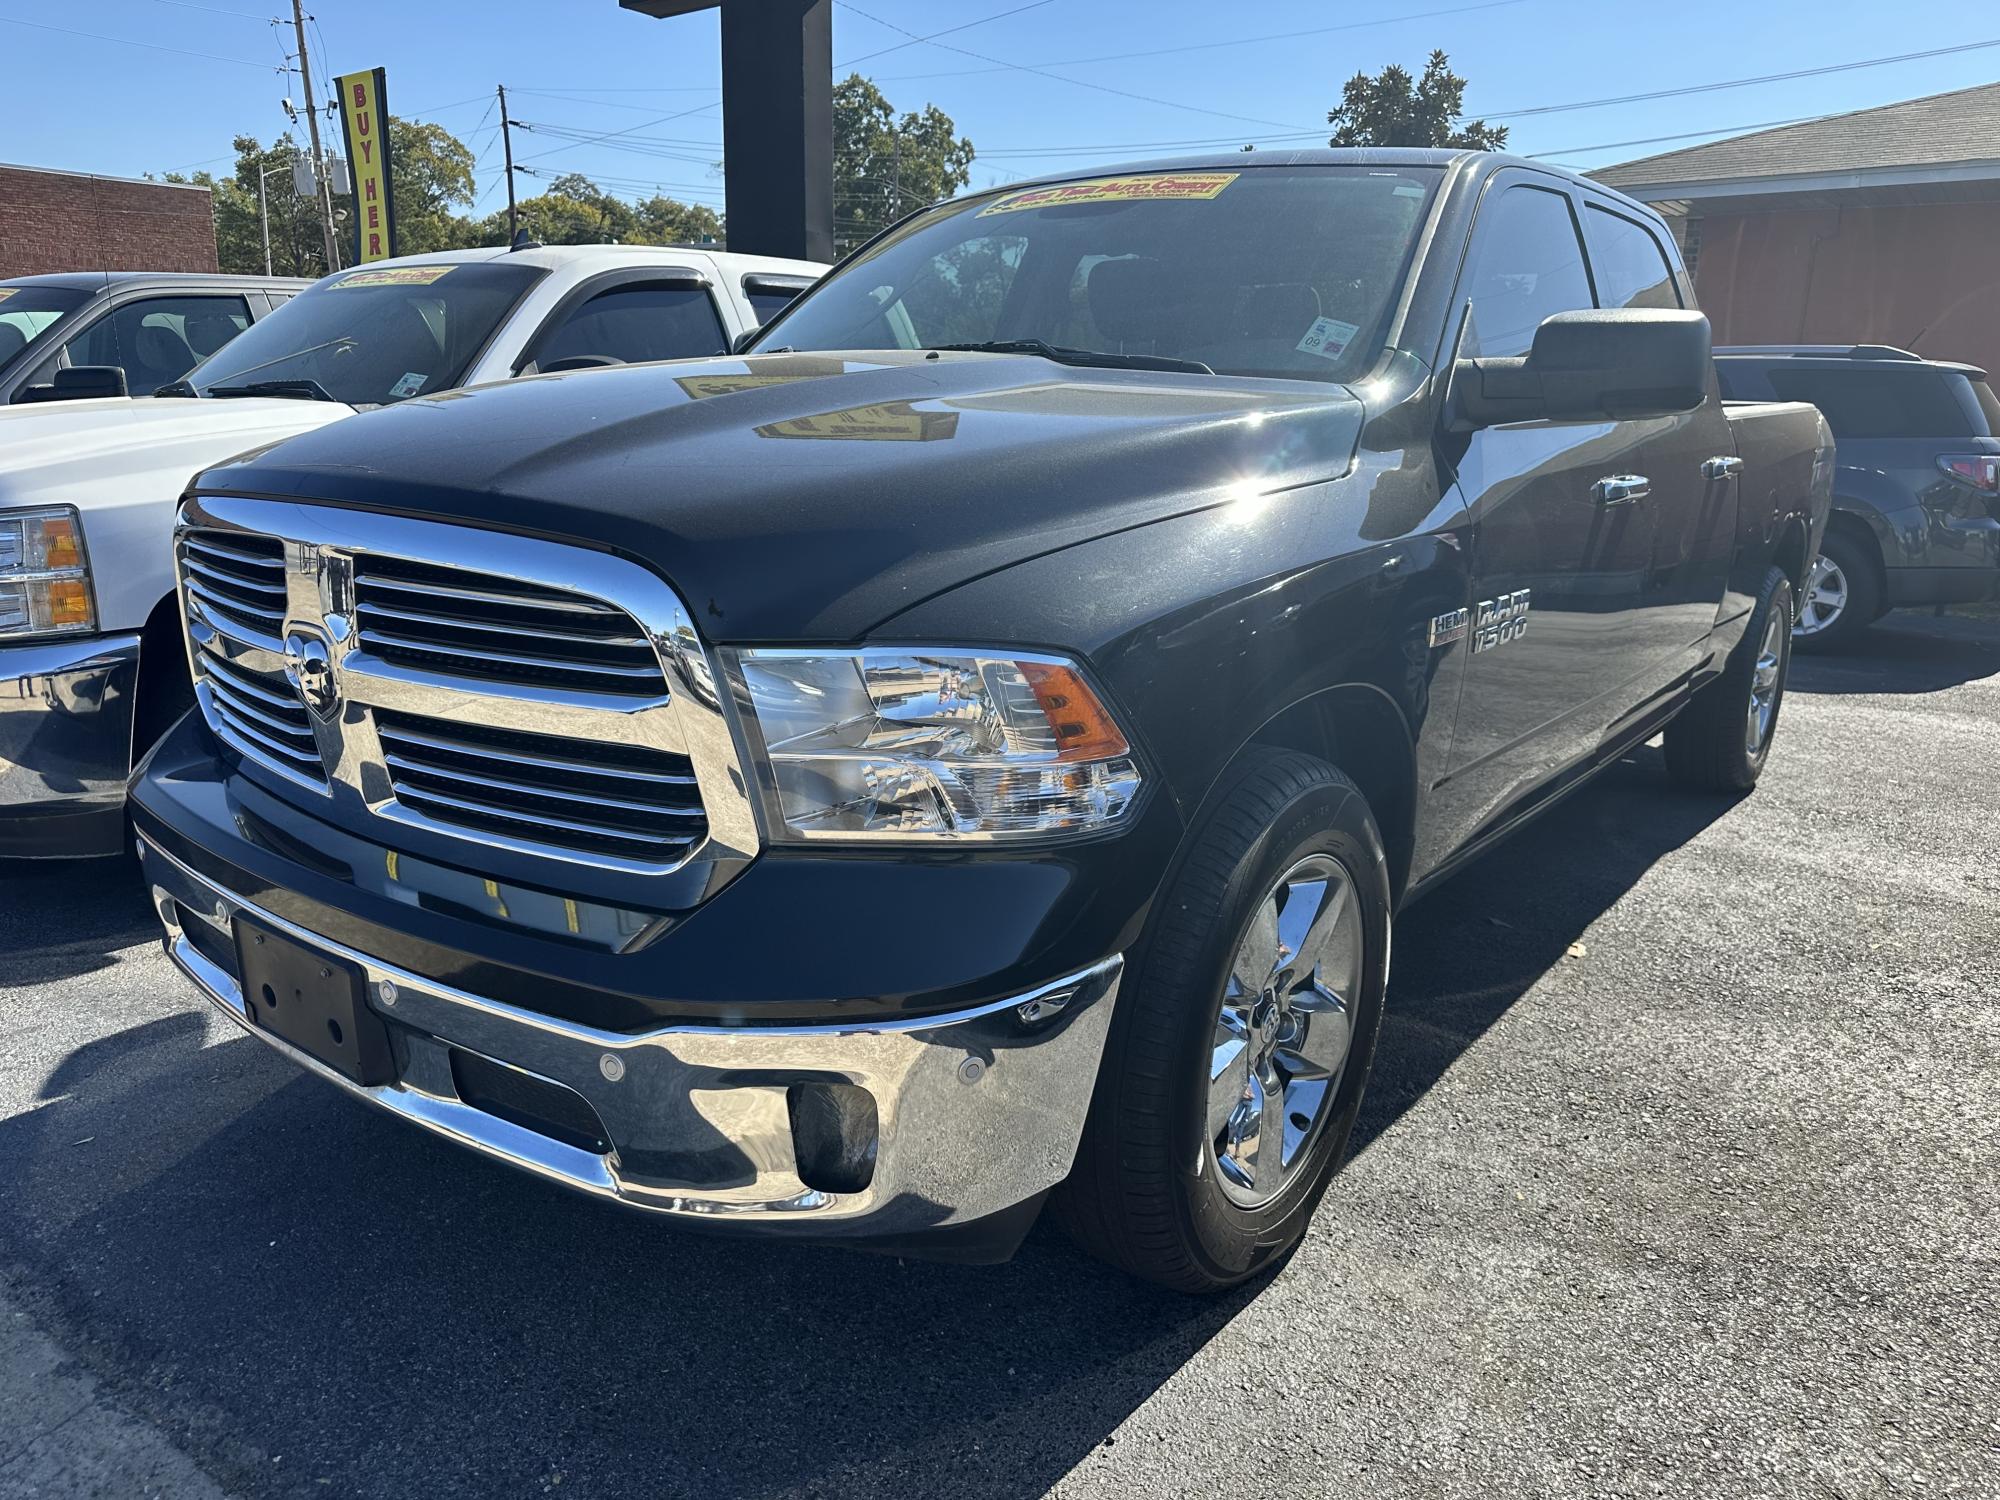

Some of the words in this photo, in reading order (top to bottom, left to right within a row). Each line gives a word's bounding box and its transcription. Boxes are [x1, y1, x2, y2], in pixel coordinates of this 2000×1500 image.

[353, 83, 372, 164] BUY
[365, 177, 382, 262] HER
[1097, 182, 1150, 192] AUTO
[1151, 178, 1226, 190] CREDIT
[1304, 336, 1321, 347] 09
[1477, 588, 1531, 627] RAM
[1473, 615, 1528, 655] 1500
